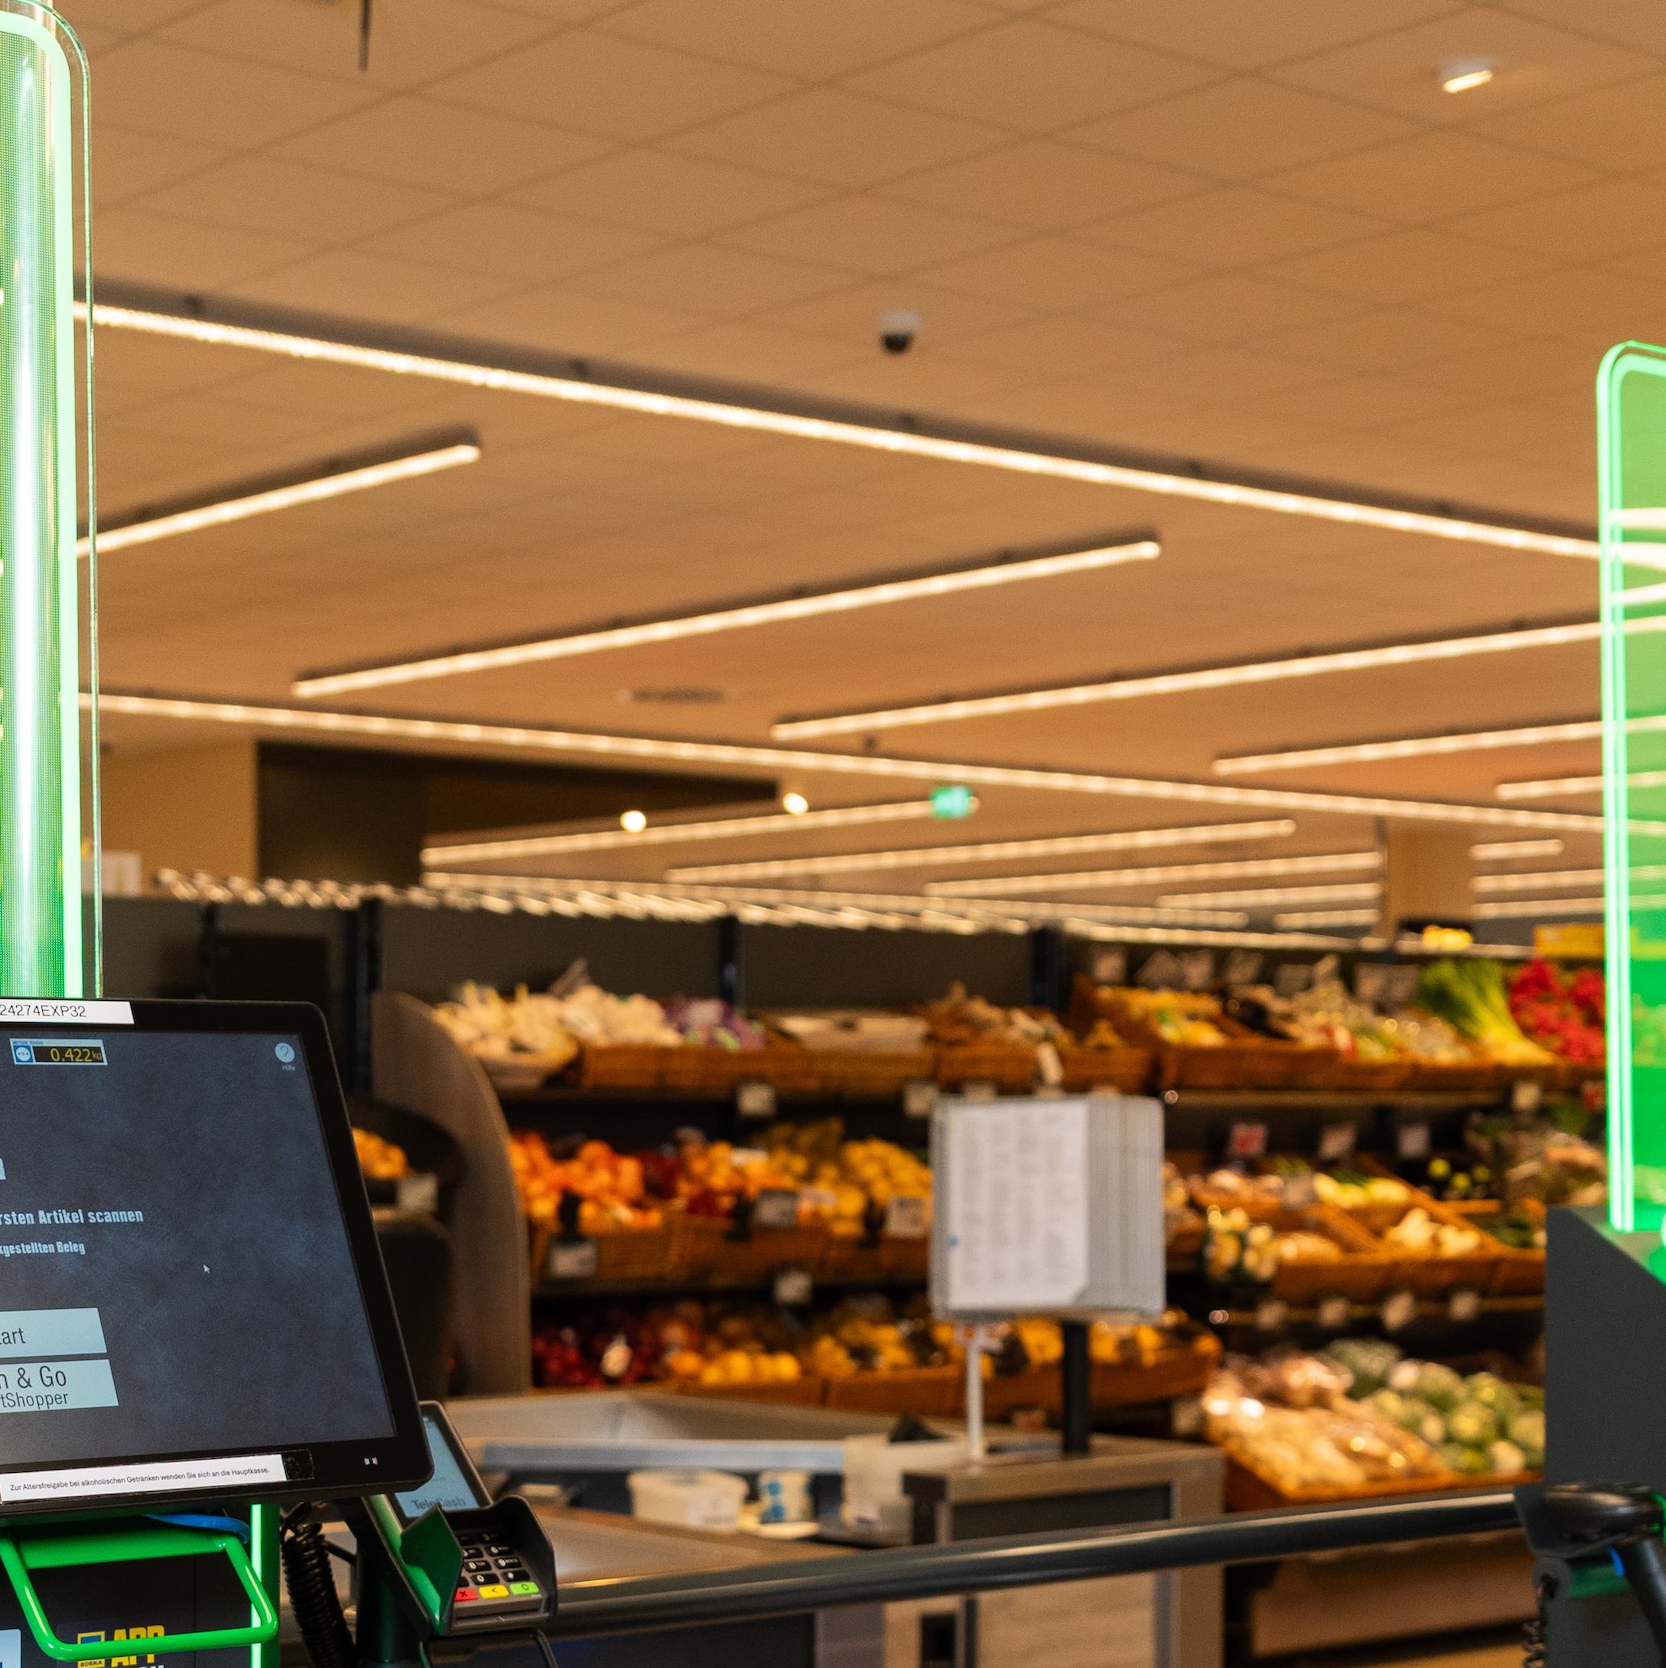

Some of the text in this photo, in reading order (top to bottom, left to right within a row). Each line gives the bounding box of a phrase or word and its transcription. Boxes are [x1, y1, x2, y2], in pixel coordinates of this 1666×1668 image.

[50, 1048, 92, 1062] 0.422
[38, 1208, 84, 1225] Artikel
[87, 1209, 144, 1223] scannen
[56, 1241, 86, 1255] Beleg
[17, 1367, 32, 1389] &
[39, 1365, 67, 1388] Go
[22, 1480, 69, 1491] Altersfreigabe
[69, 1479, 80, 1487] bei
[81, 1476, 126, 1487] alkoholischen
[127, 1474, 160, 1484] Getränken
[161, 1473, 185, 1481] wenden
[186, 1471, 196, 1479] Sie
[197, 1470, 211, 1478] sich
[220, 1469, 230, 1477] die
[110, 1625, 165, 1668] APP
